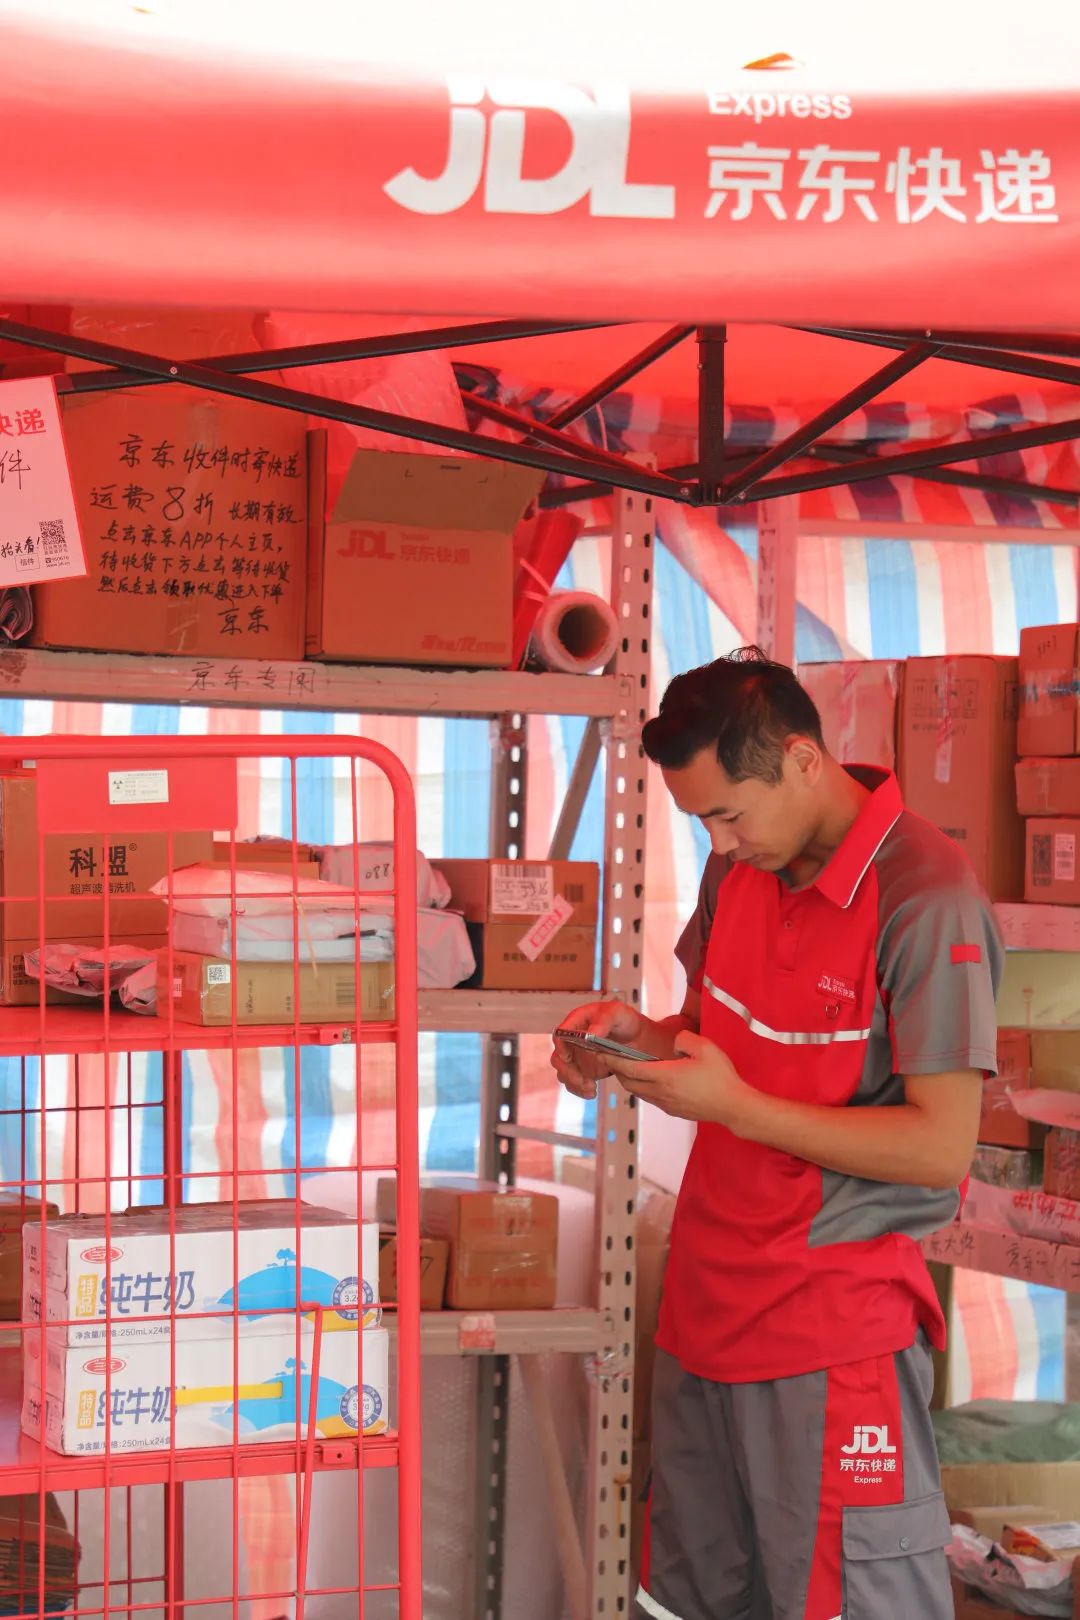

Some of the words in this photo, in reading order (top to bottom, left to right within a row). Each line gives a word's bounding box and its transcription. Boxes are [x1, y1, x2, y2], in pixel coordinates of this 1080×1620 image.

[706, 88, 852, 124] Express
[382, 74, 675, 219] JDL
[704, 142, 1059, 224] 京东快递
[99, 1271, 195, 1314] 纯牛奶
[97, 1386, 178, 1427] 纯牛奶
[841, 1424, 896, 1454] JDL
[839, 1458, 896, 1472] 京东快递
[854, 1476, 883, 1484] Express
